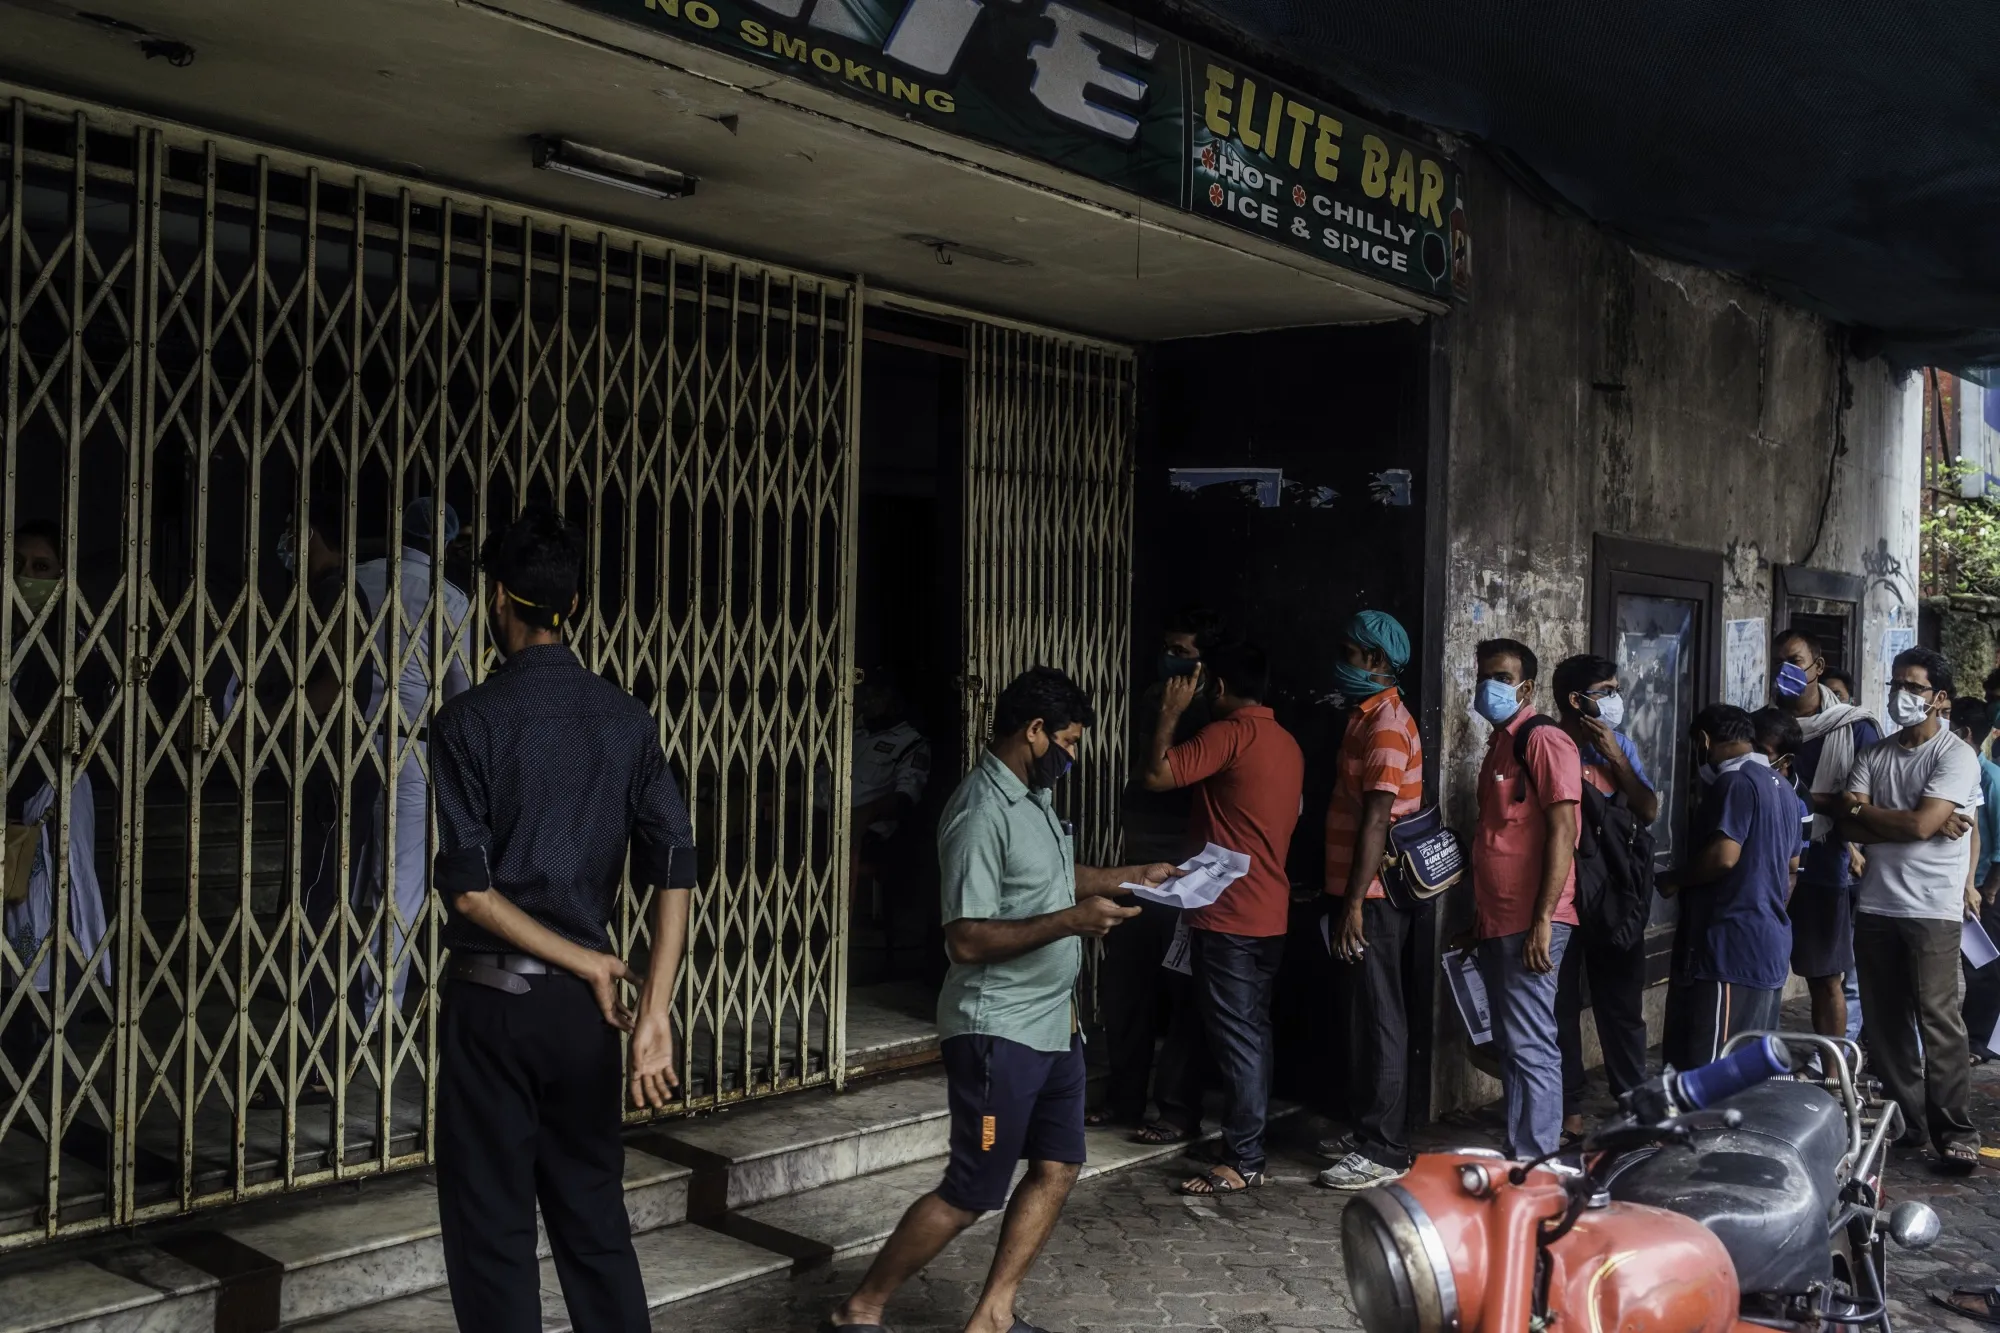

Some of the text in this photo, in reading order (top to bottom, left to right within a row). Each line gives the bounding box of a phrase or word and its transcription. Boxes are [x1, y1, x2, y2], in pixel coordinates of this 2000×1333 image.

[643, 0, 720, 29] NO
[740, 19, 956, 114] SMOKING
[1204, 63, 1343, 183] ELITE
[1360, 134, 1444, 228] BAR
[1219, 154, 1416, 246] HOT CHILLY
[1226, 190, 1408, 273] ICE & SPICE
